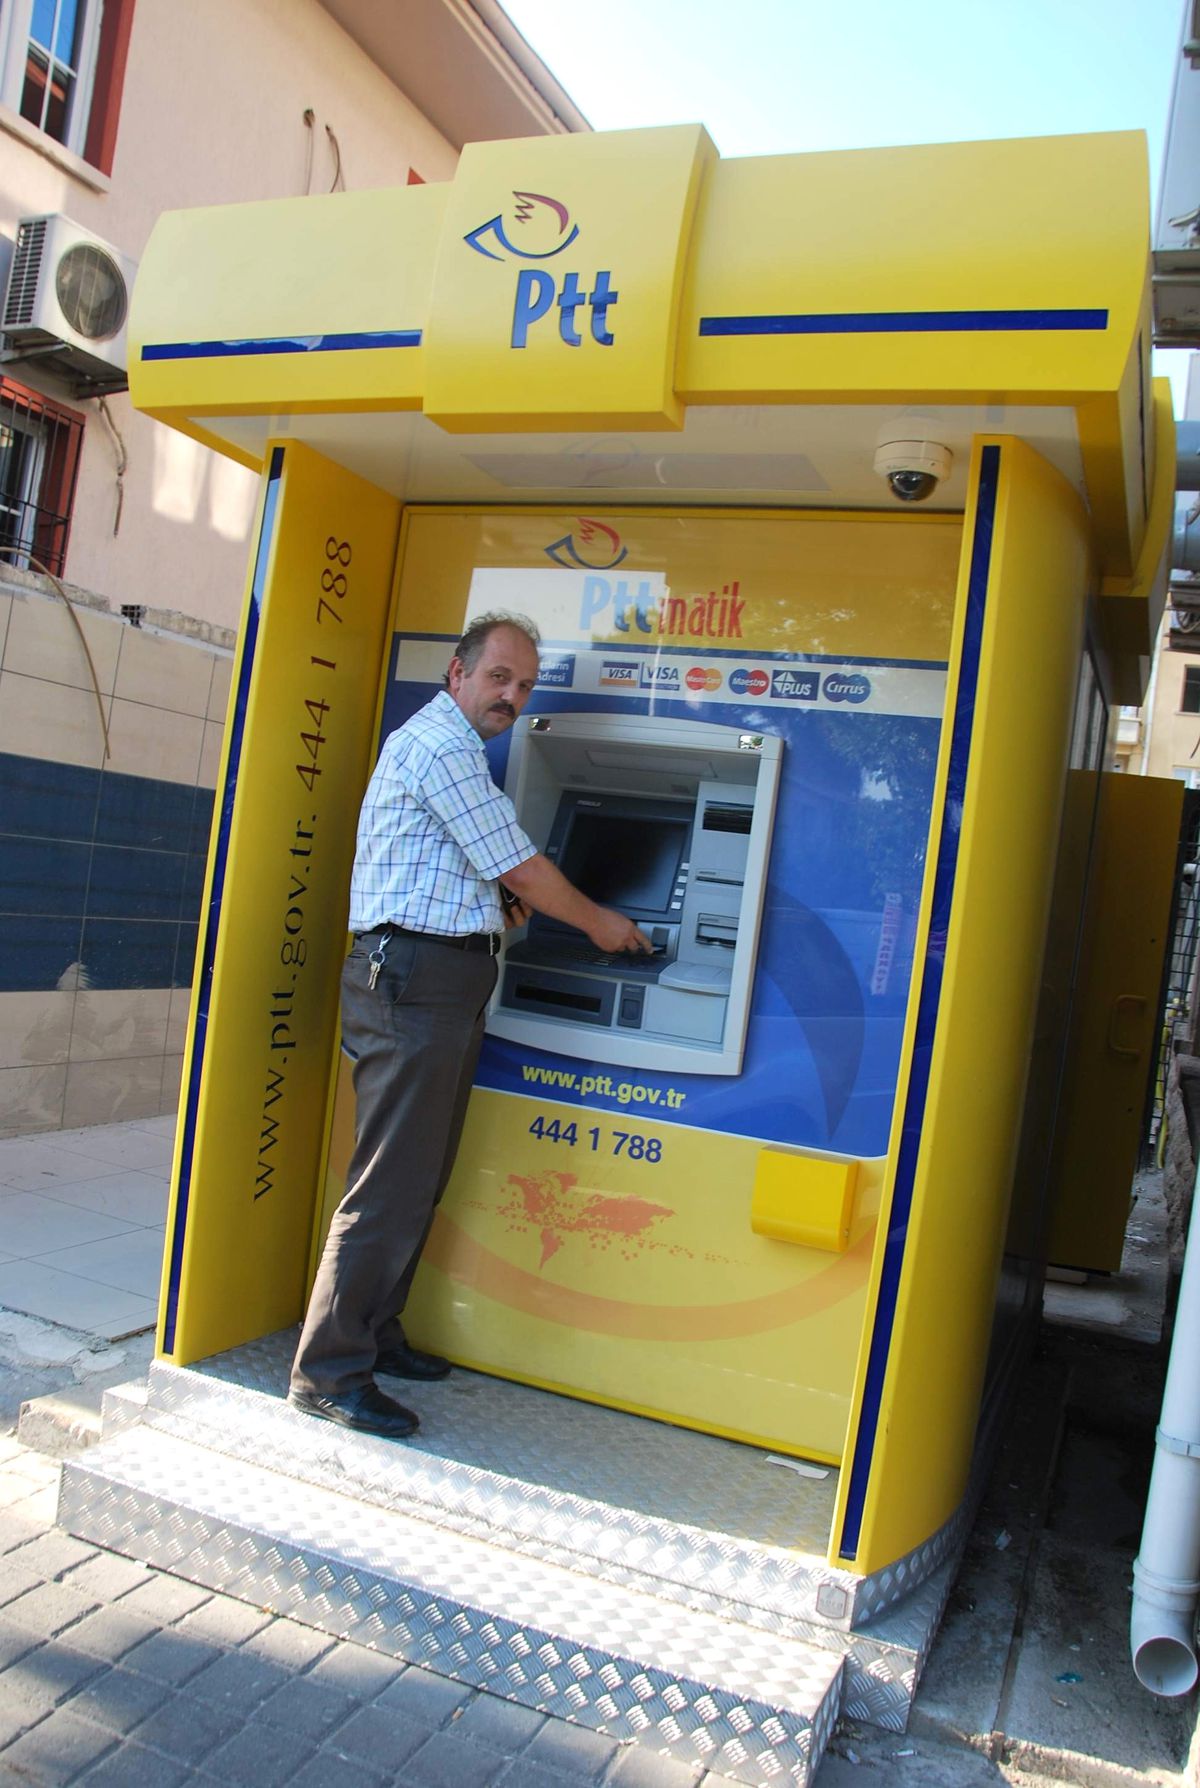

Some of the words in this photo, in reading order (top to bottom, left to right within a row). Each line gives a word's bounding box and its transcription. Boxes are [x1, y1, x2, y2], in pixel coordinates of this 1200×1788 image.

[511, 269, 618, 348] Ptt
[316, 536, 352, 624] 788
[579, 575, 745, 638] Pttmatik
[311, 656, 336, 670] 1
[608, 668, 633, 679] VISA
[646, 666, 679, 681] VISA
[732, 677, 766, 688] Maestro
[781, 683, 812, 696] PLUS
[826, 680, 865, 695] Cirrus
[296, 698, 330, 791] 444
[522, 1065, 686, 1109] www.ptt.gov.tr
[529, 1116, 578, 1146] 444
[588, 1127, 600, 1151] 1
[612, 1131, 662, 1164] 788
